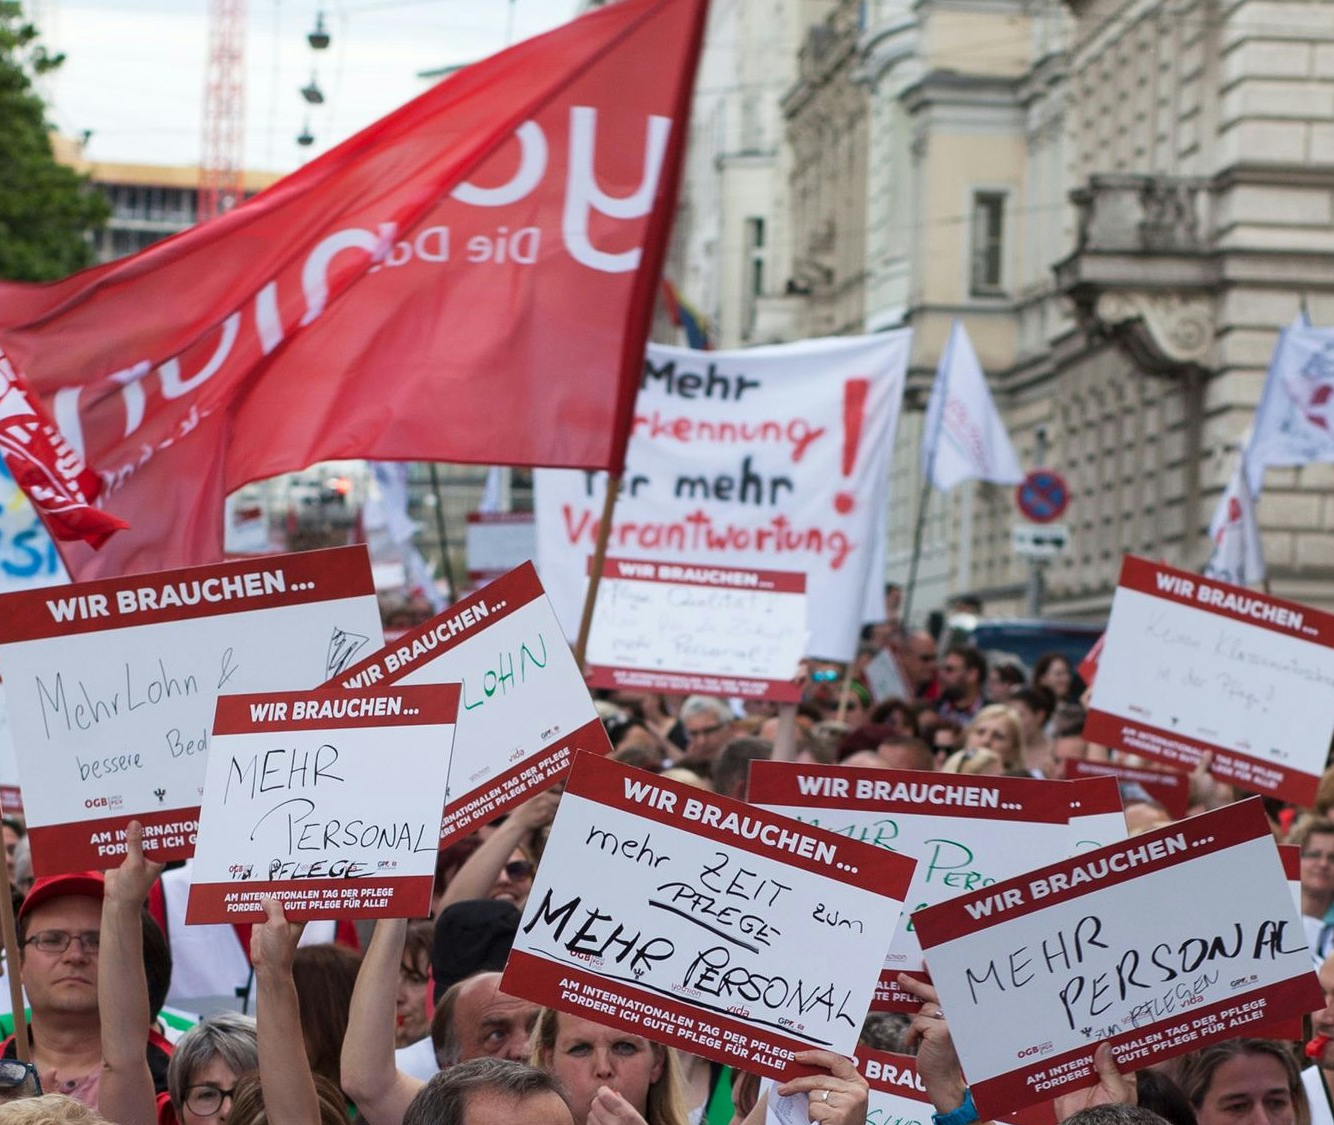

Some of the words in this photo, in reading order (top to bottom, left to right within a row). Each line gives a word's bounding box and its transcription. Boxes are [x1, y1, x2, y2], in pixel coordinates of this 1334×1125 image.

[640, 361, 760, 400] Mehr
[675, 456, 794, 505] mehr
[46, 594, 109, 623] WIR
[1156, 572, 1193, 598] WIR
[35, 672, 118, 739] Mehr
[126, 659, 198, 711] Lohn
[461, 633, 547, 710] LOHN
[250, 703, 287, 722] WIR
[76, 753, 144, 782] bessere
[223, 744, 344, 805] MEHR
[623, 777, 678, 814] WIR
[797, 775, 849, 798] WIR
[250, 798, 439, 856] PERSONAL
[268, 858, 377, 881] PFLEGE
[585, 825, 671, 869] mehr
[699, 852, 793, 906] ZEIT
[812, 902, 865, 934] zum
[658, 882, 783, 947] PFLEGE
[964, 889, 1026, 921] WIR
[523, 887, 675, 972] MEHR
[683, 946, 856, 1028] PERSONAL
[966, 915, 1109, 1005] MEHR
[1059, 920, 1309, 1030] PERSONAL
[559, 978, 579, 991] AM
[582, 984, 694, 1028] INTERNATIONALEN
[698, 1022, 720, 1036] TAG
[723, 1031, 747, 1045] DER
[751, 1040, 796, 1061] PFLEGE
[1130, 970, 1220, 1031] PFLEGEN
[562, 991, 616, 1015] FORDERE
[619, 1010, 640, 1023] ICH
[643, 1017, 674, 1034] GUTE
[677, 1028, 722, 1048] PFLEGE
[725, 1042, 749, 1058] FÜR
[752, 1054, 786, 1071] ALLE!
